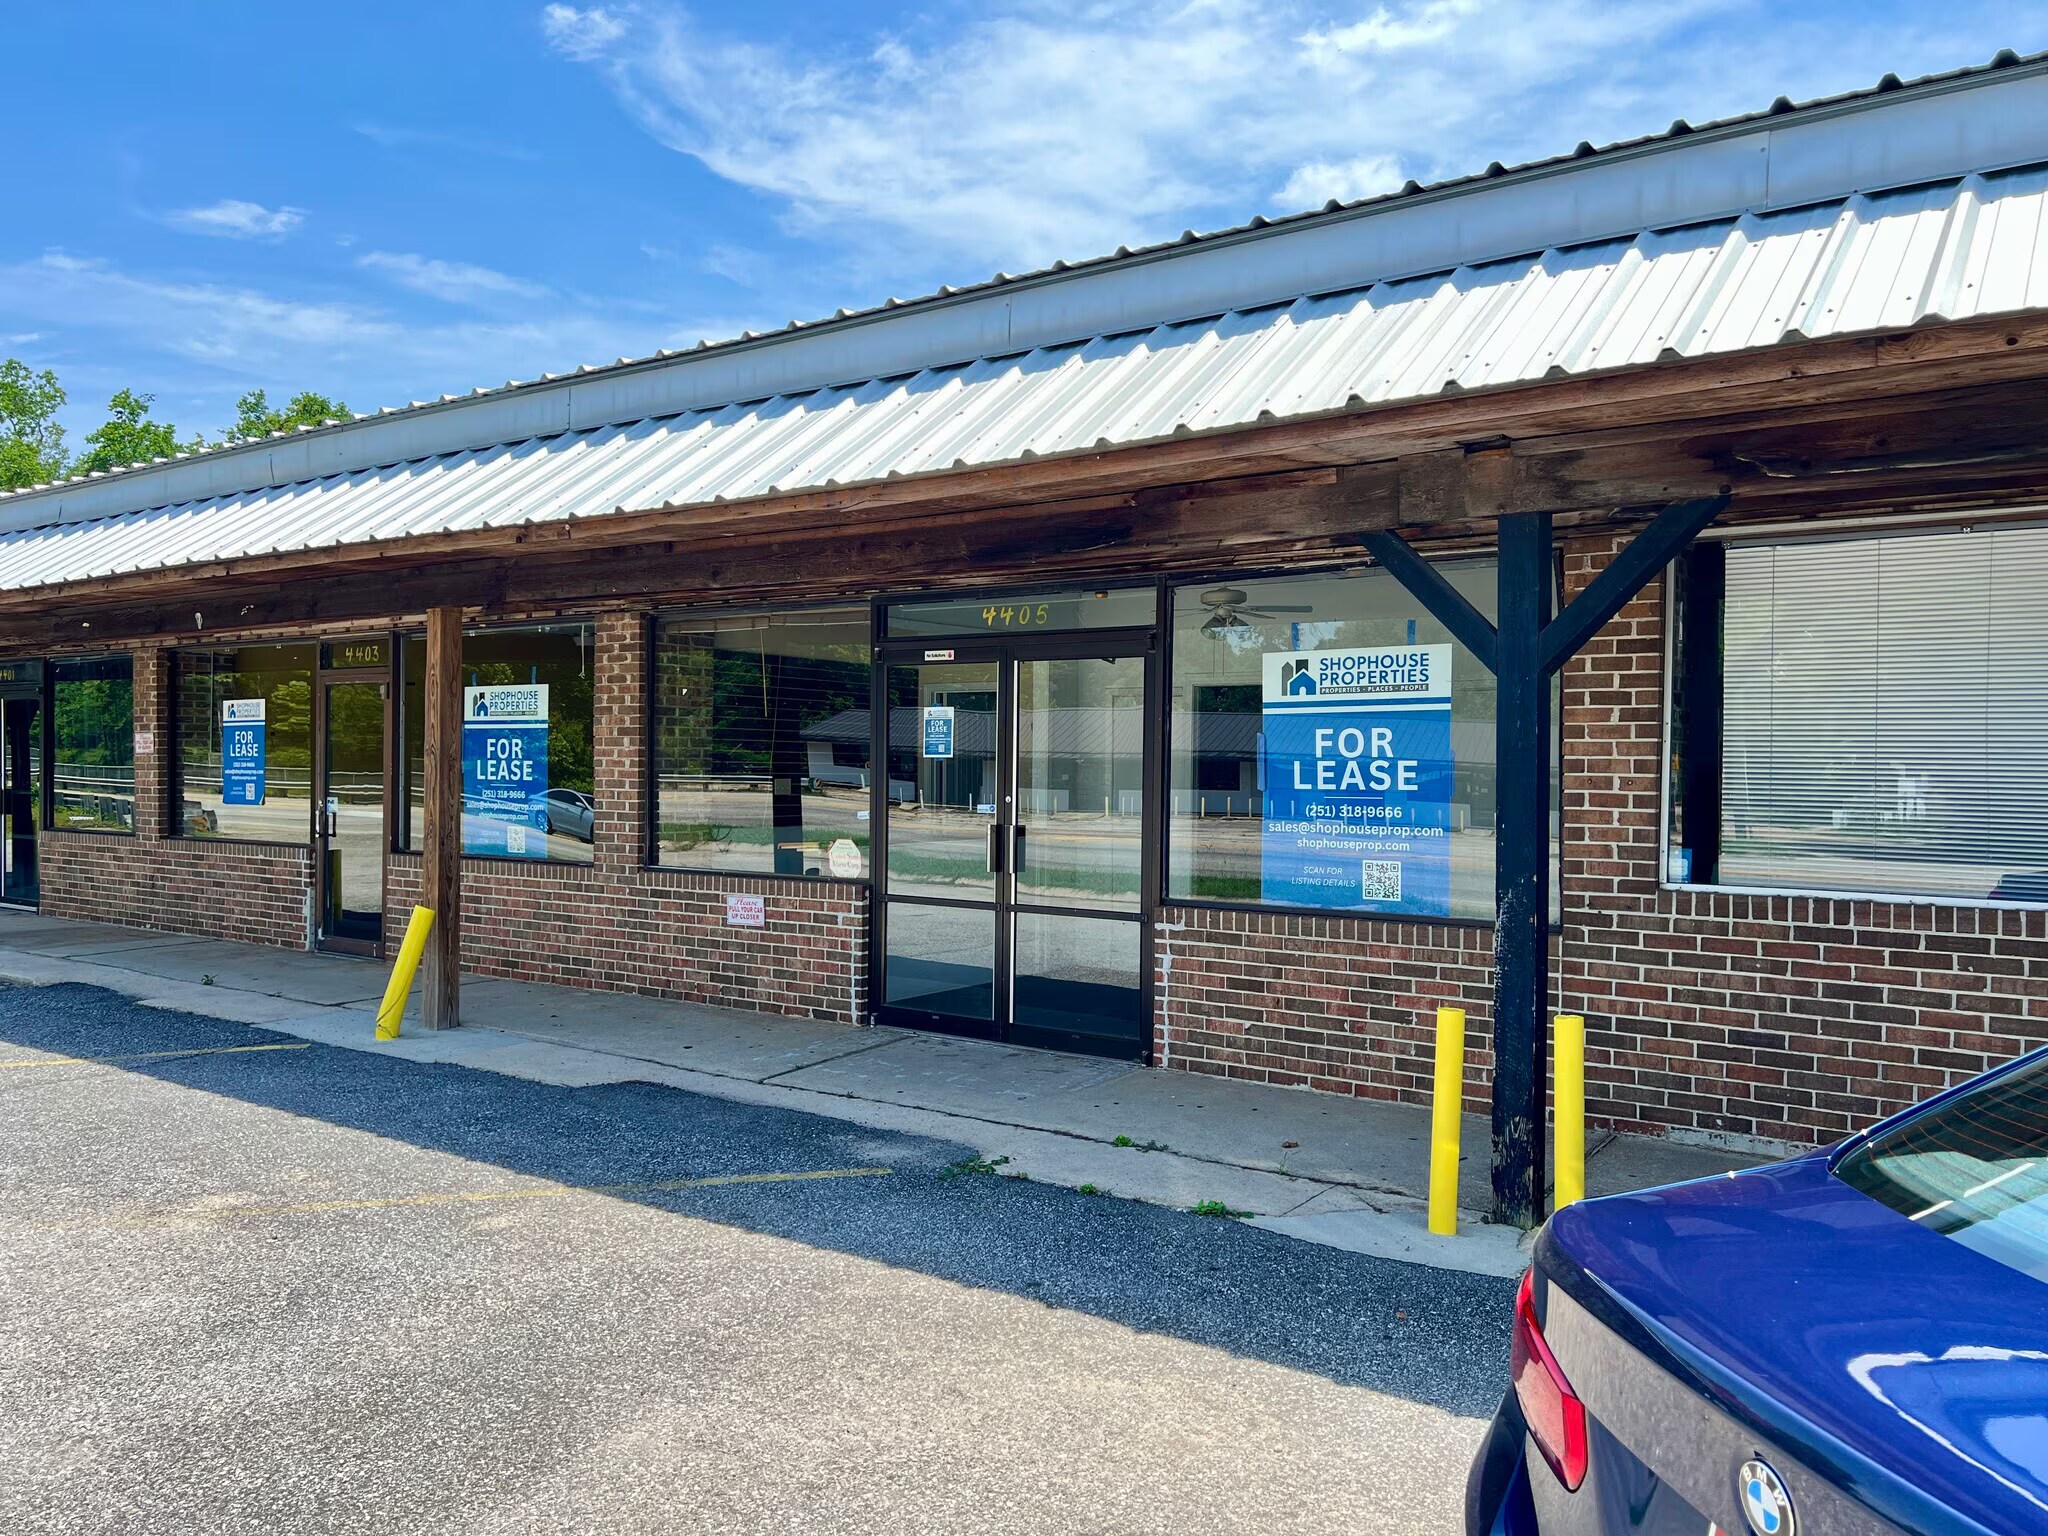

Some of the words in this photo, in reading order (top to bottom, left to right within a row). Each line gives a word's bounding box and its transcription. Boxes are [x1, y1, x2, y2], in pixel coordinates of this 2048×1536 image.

[982, 604, 1049, 626] 4405
[345, 645, 379, 663] 4403
[1319, 653, 1430, 671] SHOPHOUSE
[1319, 668, 1430, 686] PROPERTIES
[489, 690, 539, 701] SHOPHOUSE
[1321, 686, 1361, 694] PROPERTIES
[1400, 683, 1428, 691] PEOPLE
[489, 700, 539, 711] PROPERTIES
[235, 730, 254, 744] FOR
[1315, 727, 1394, 758] FOR
[230, 743, 259, 757] LEASE
[486, 738, 523, 759] FOR
[476, 759, 533, 781] LEASE
[1293, 760, 1419, 791] LEASE
[482, 789, 497, 799] (251)
[496, 790, 526, 799] 318-9666
[1305, 804, 1336, 818] (251)
[1338, 805, 1403, 819] 318-9666
[1268, 821, 1444, 838] sales@shophouseprop.com
[1297, 837, 1410, 852] shophouseprop.com
[1303, 866, 1325, 874] SCAN
[1326, 867, 1343, 875] FOR
[1291, 877, 1321, 886] LISTING
[1322, 879, 1356, 888] DETAILS
[734, 896, 758, 906] Please
[1742, 1466, 1786, 1506] BMW
